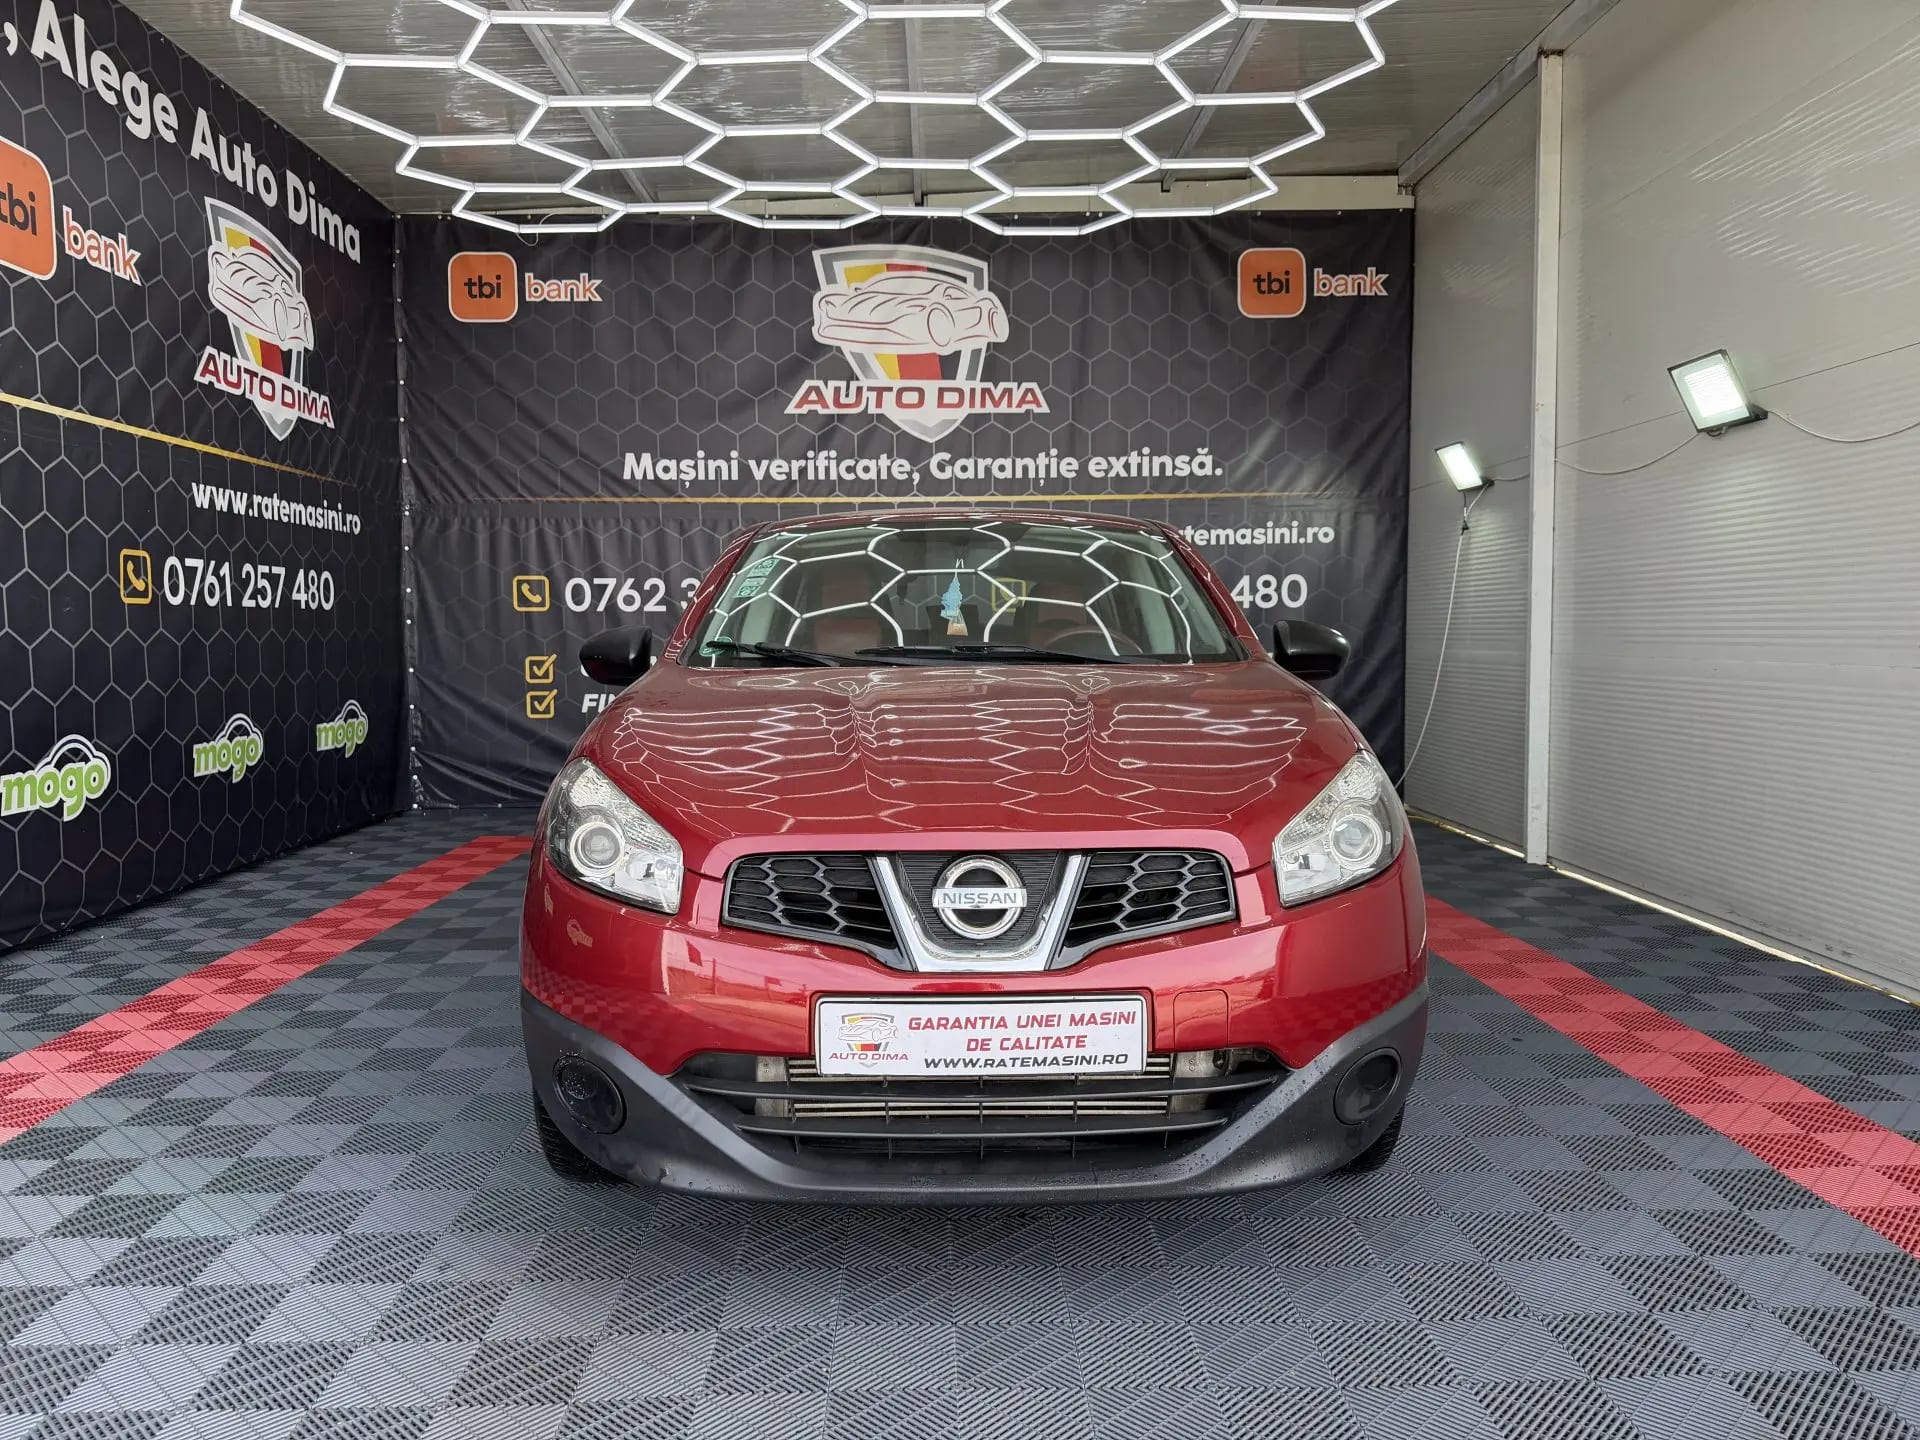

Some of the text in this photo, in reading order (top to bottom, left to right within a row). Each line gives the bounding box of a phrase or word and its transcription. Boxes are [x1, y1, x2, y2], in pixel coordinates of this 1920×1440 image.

[31, 0, 361, 264] Alege Auto Dima
[63, 205, 142, 286] bank
[464, 272, 602, 302] tbi bank
[1253, 267, 1389, 296] tbi bank
[200, 352, 331, 423] AUTO DIMA
[794, 386, 1042, 409] AUTO DIMA
[623, 447, 1223, 488] Mașini verificate, Garanție extinsă.
[192, 482, 361, 535] www.ratemasini.ro
[163, 555, 335, 611] 0761 257 480
[565, 577, 666, 612] 0762
[1231, 573, 1308, 609] 480
[317, 717, 368, 758] mogo
[193, 735, 262, 783] mogo
[1, 762, 108, 820] mogo
[943, 892, 1017, 905] NISSAN
[908, 1011, 1136, 1031] GARANTIA UNEI MASINI
[829, 1052, 909, 1061] AUTO DIMA
[924, 1053, 1128, 1069] WWW.RATEMASINI.RO
[966, 1035, 1087, 1051] DE CALITATE
